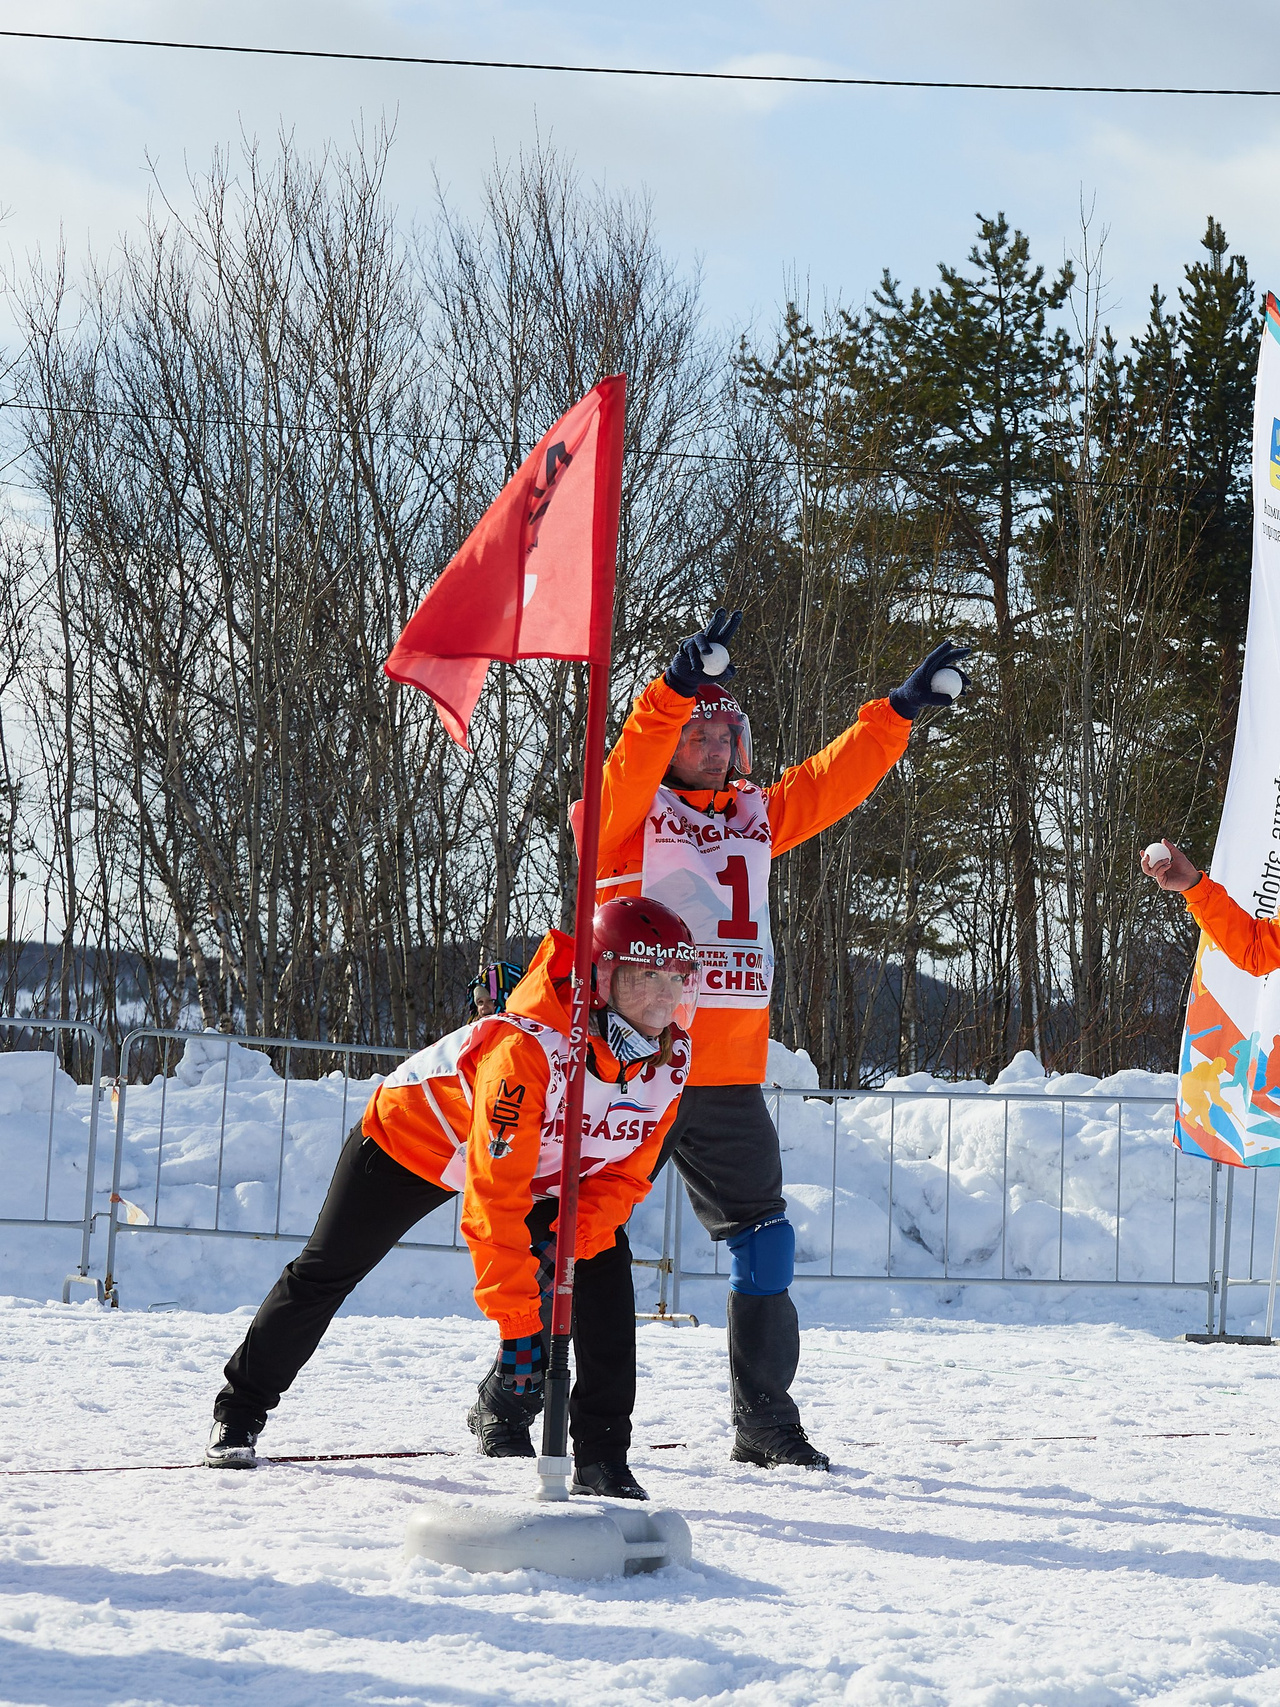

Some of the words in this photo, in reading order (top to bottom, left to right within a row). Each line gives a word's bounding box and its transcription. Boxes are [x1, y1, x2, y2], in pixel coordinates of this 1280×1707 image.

[716, 855, 758, 940] 1
[619, 955, 651, 964] МУРМАНСК
[569, 988, 585, 1082] LISKI
